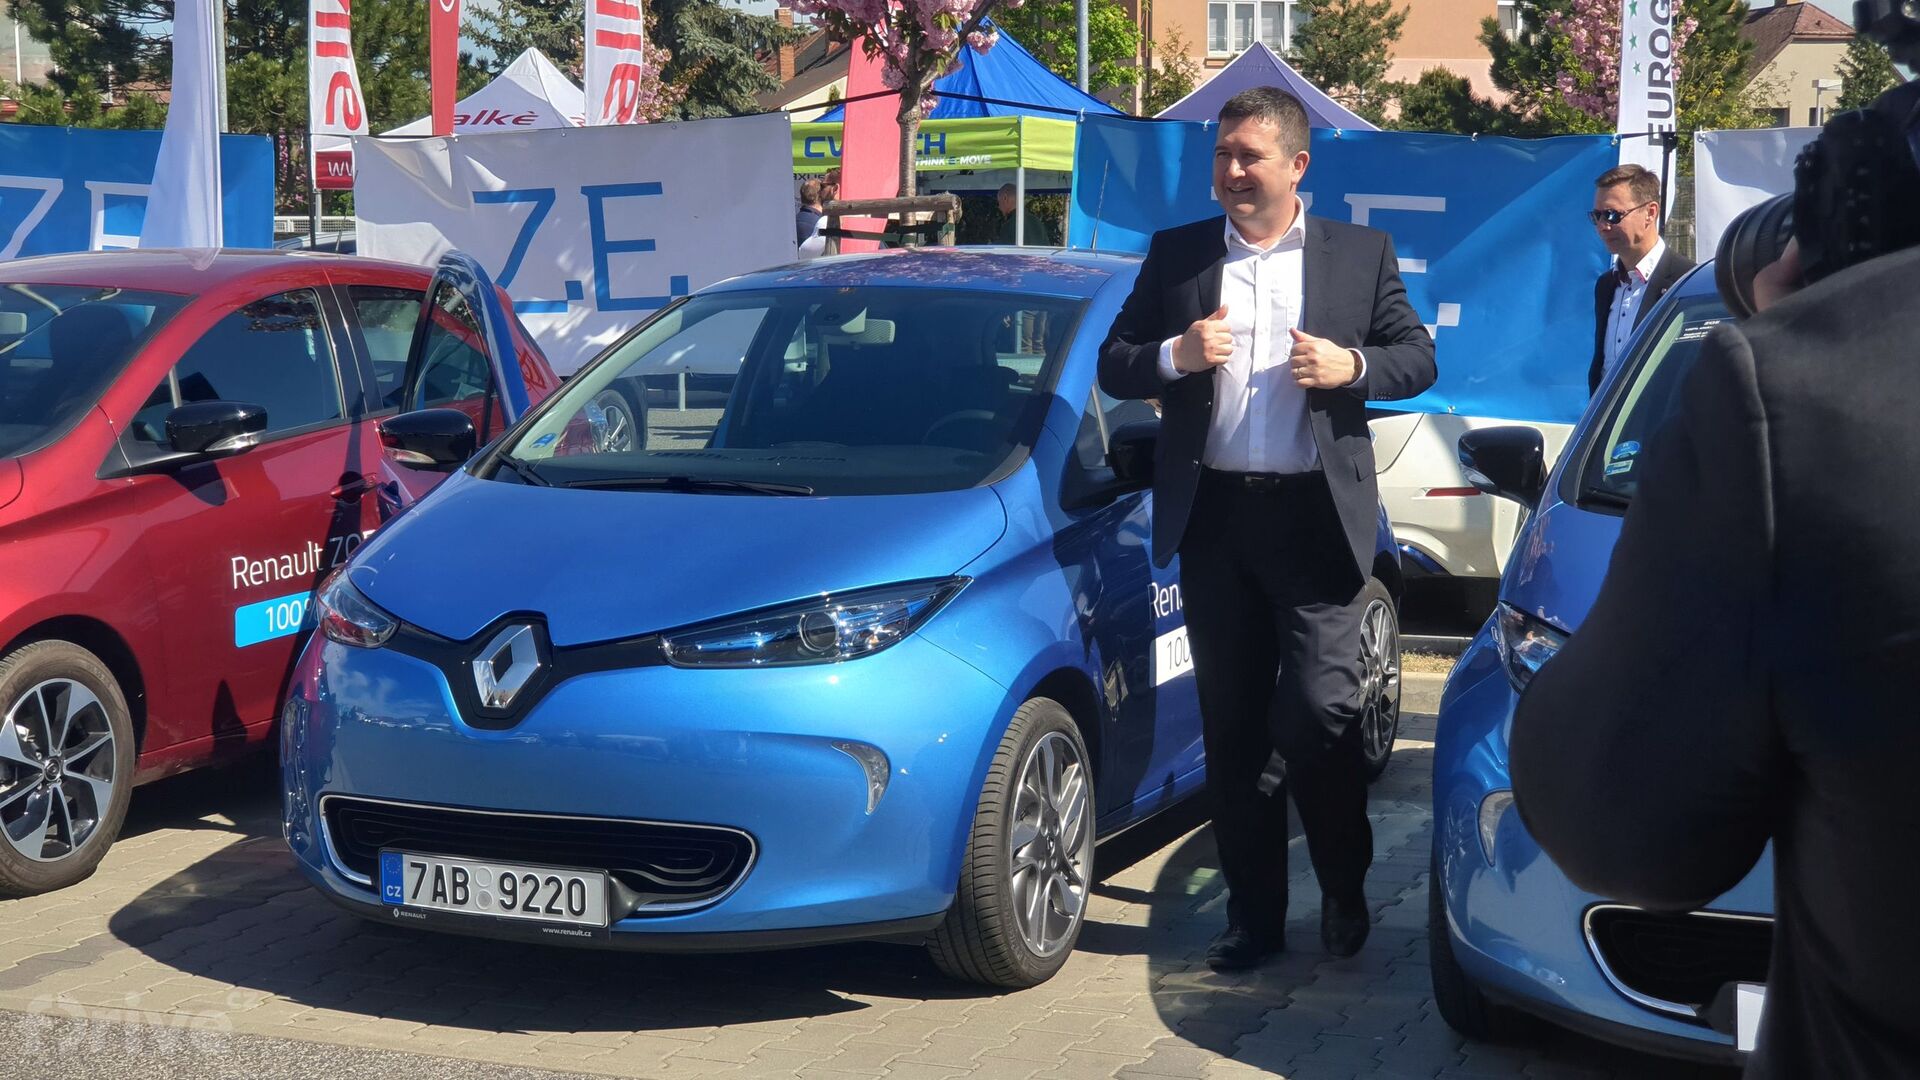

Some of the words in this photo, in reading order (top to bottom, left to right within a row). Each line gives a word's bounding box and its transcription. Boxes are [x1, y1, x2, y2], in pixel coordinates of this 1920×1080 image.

[959, 154, 993, 165] MOVE
[231, 541, 323, 590] Renault
[1147, 582, 1183, 621] Ren
[386, 884, 402, 898] CZ
[410, 860, 471, 906] 7AB
[499, 871, 586, 918] 9220
[400, 911, 427, 921] RENAULT
[541, 926, 592, 938] www.renault.cz
